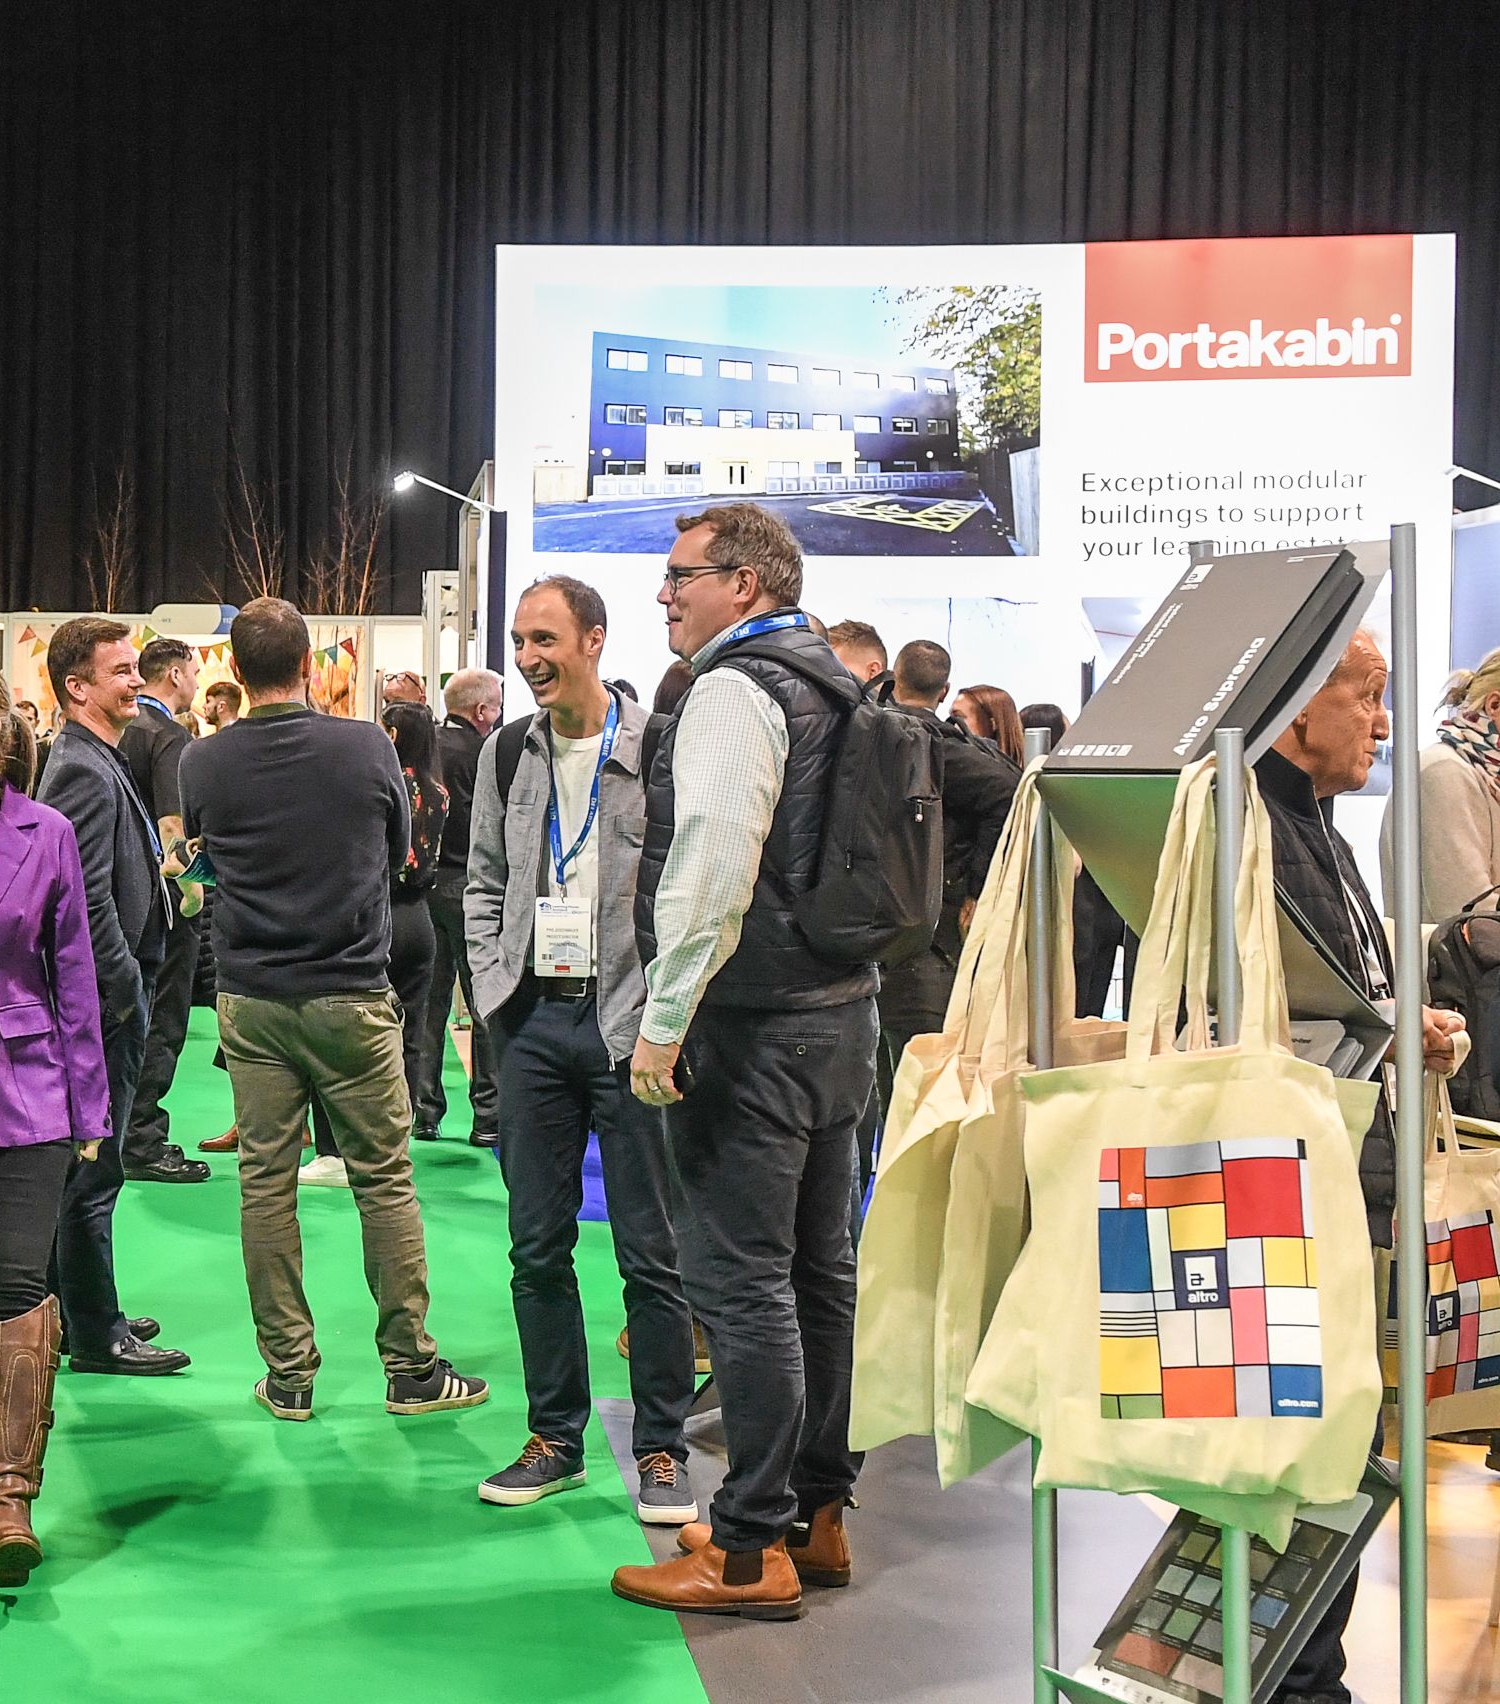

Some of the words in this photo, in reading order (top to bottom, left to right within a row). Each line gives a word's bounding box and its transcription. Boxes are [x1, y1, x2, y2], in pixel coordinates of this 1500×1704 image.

[1098, 315, 1399, 370] Portakabin
[1082, 471, 1243, 496] Exceptional
[1253, 470, 1368, 490] modular
[1081, 504, 1208, 528] buildings
[1217, 505, 1243, 523] to
[1253, 503, 1364, 527] support
[1082, 542, 1143, 562] your
[1172, 715, 1209, 757] Altro
[1202, 636, 1266, 713] Suprema
[601, 727, 614, 757] DELABIE
[1187, 1290, 1219, 1304] altro
[1277, 1398, 1319, 1408] altro.com
